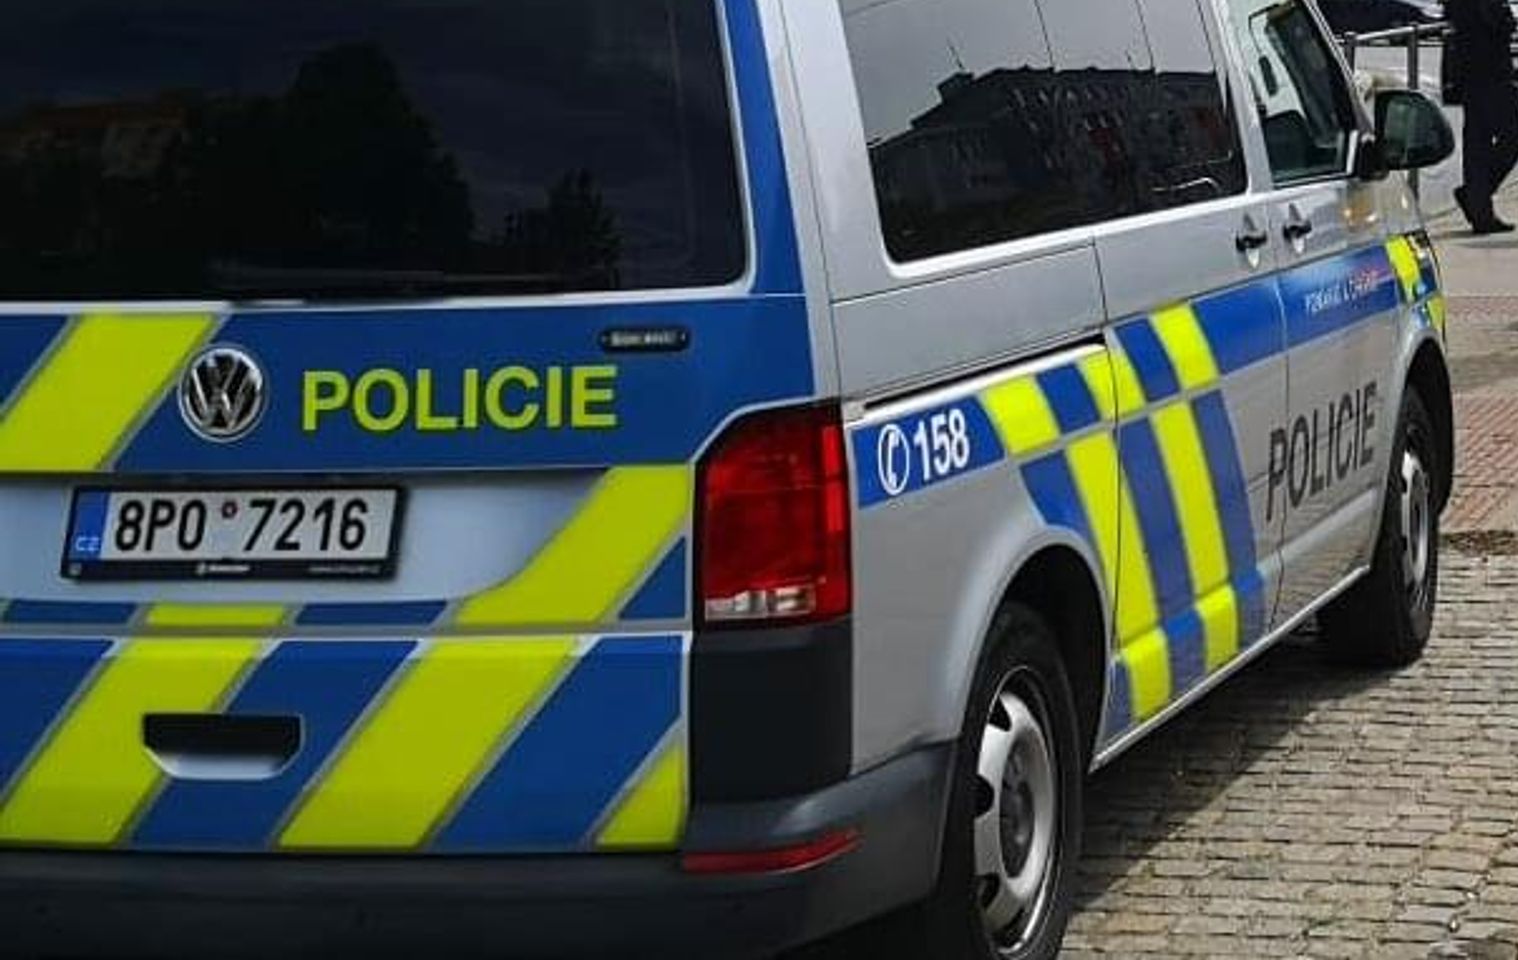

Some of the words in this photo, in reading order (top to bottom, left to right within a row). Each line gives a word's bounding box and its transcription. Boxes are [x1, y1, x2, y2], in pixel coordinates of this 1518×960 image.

[302, 364, 618, 432] POLICIE
[913, 408, 971, 481] 158
[1266, 380, 1378, 522] POLICIE
[243, 497, 370, 553] 7216
